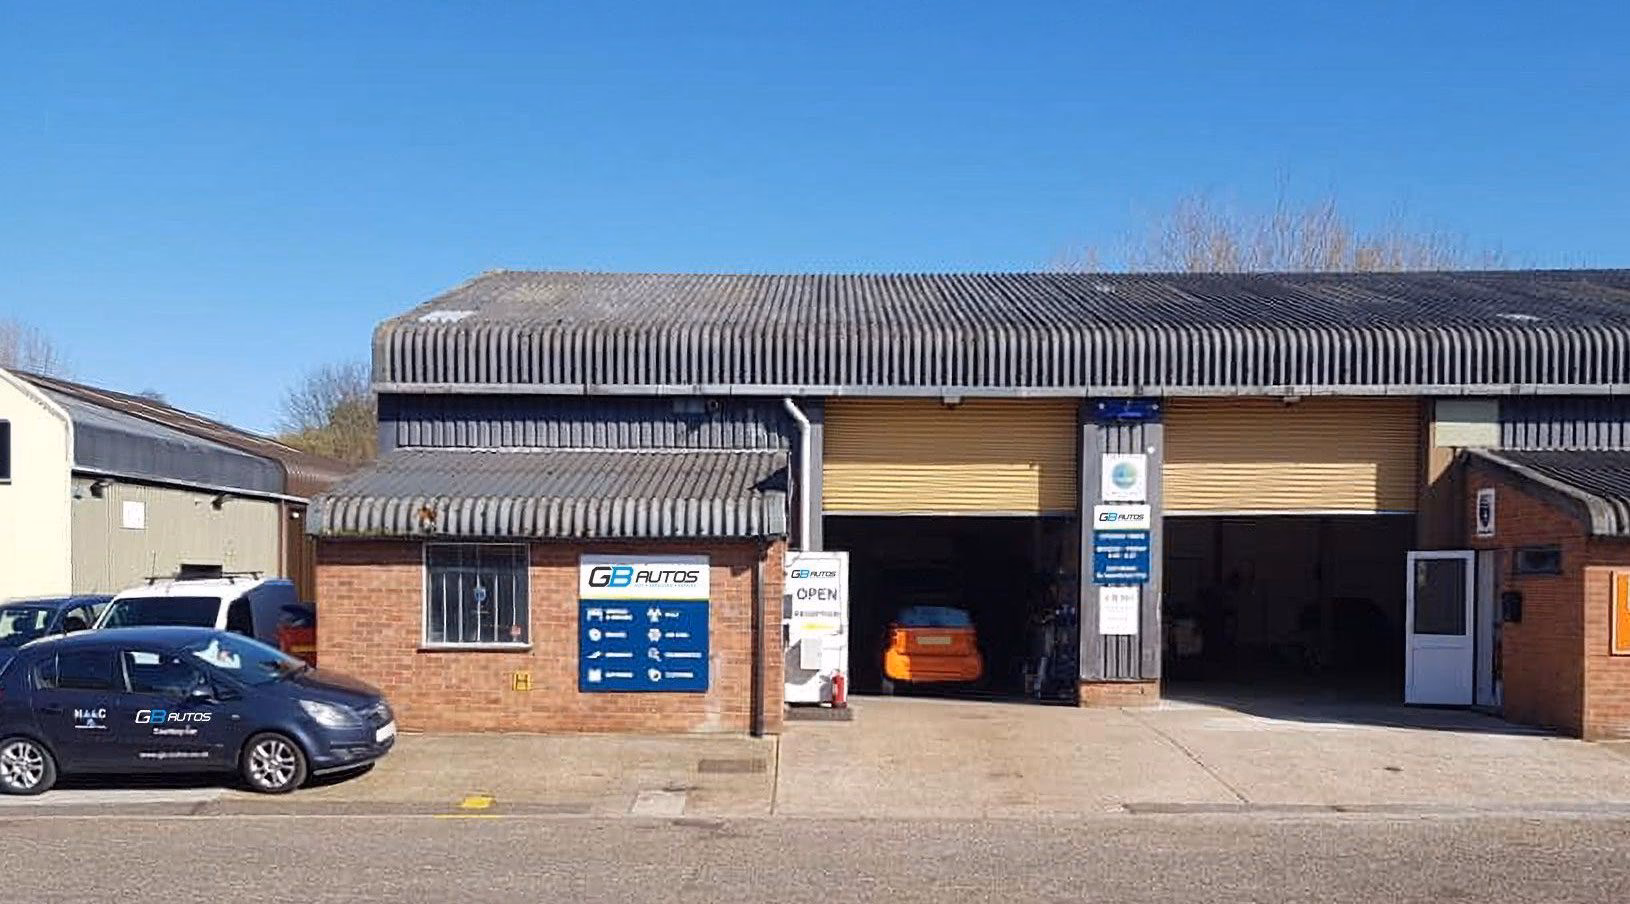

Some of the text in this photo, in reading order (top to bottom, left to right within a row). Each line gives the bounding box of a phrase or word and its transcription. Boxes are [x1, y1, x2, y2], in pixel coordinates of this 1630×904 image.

[1099, 512, 1118, 522] GB
[588, 566, 700, 588] GB AUTOS
[791, 569, 809, 578] GB
[797, 588, 837, 600] OPEN
[135, 709, 212, 724] GB AUTOS
